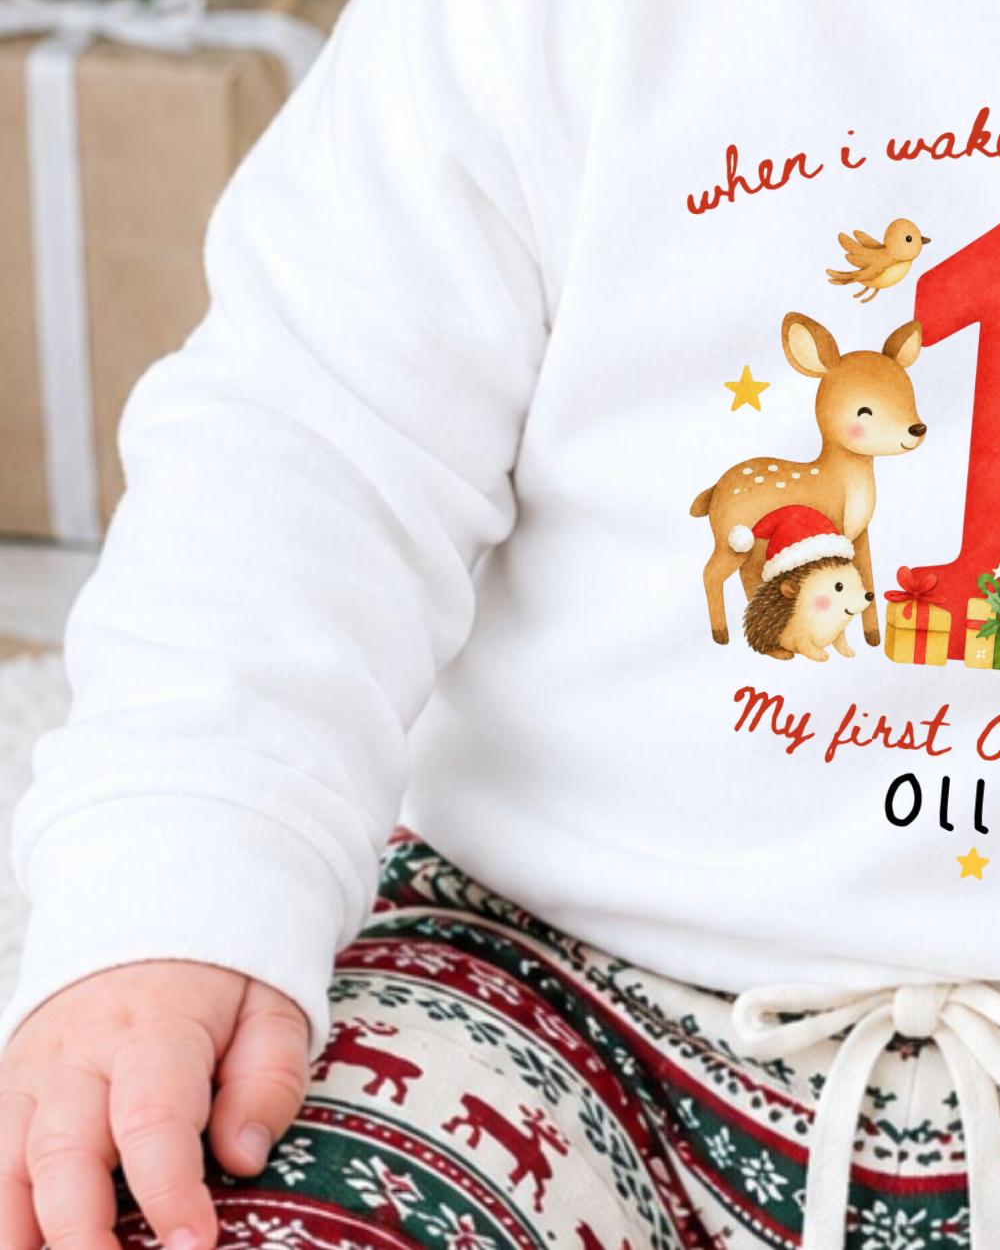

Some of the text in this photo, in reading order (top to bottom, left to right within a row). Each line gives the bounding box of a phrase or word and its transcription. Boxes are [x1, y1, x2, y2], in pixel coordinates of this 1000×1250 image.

[686, 144, 824, 215] when
[840, 129, 867, 169] i
[733, 685, 815, 755] My
[824, 703, 952, 764] first
